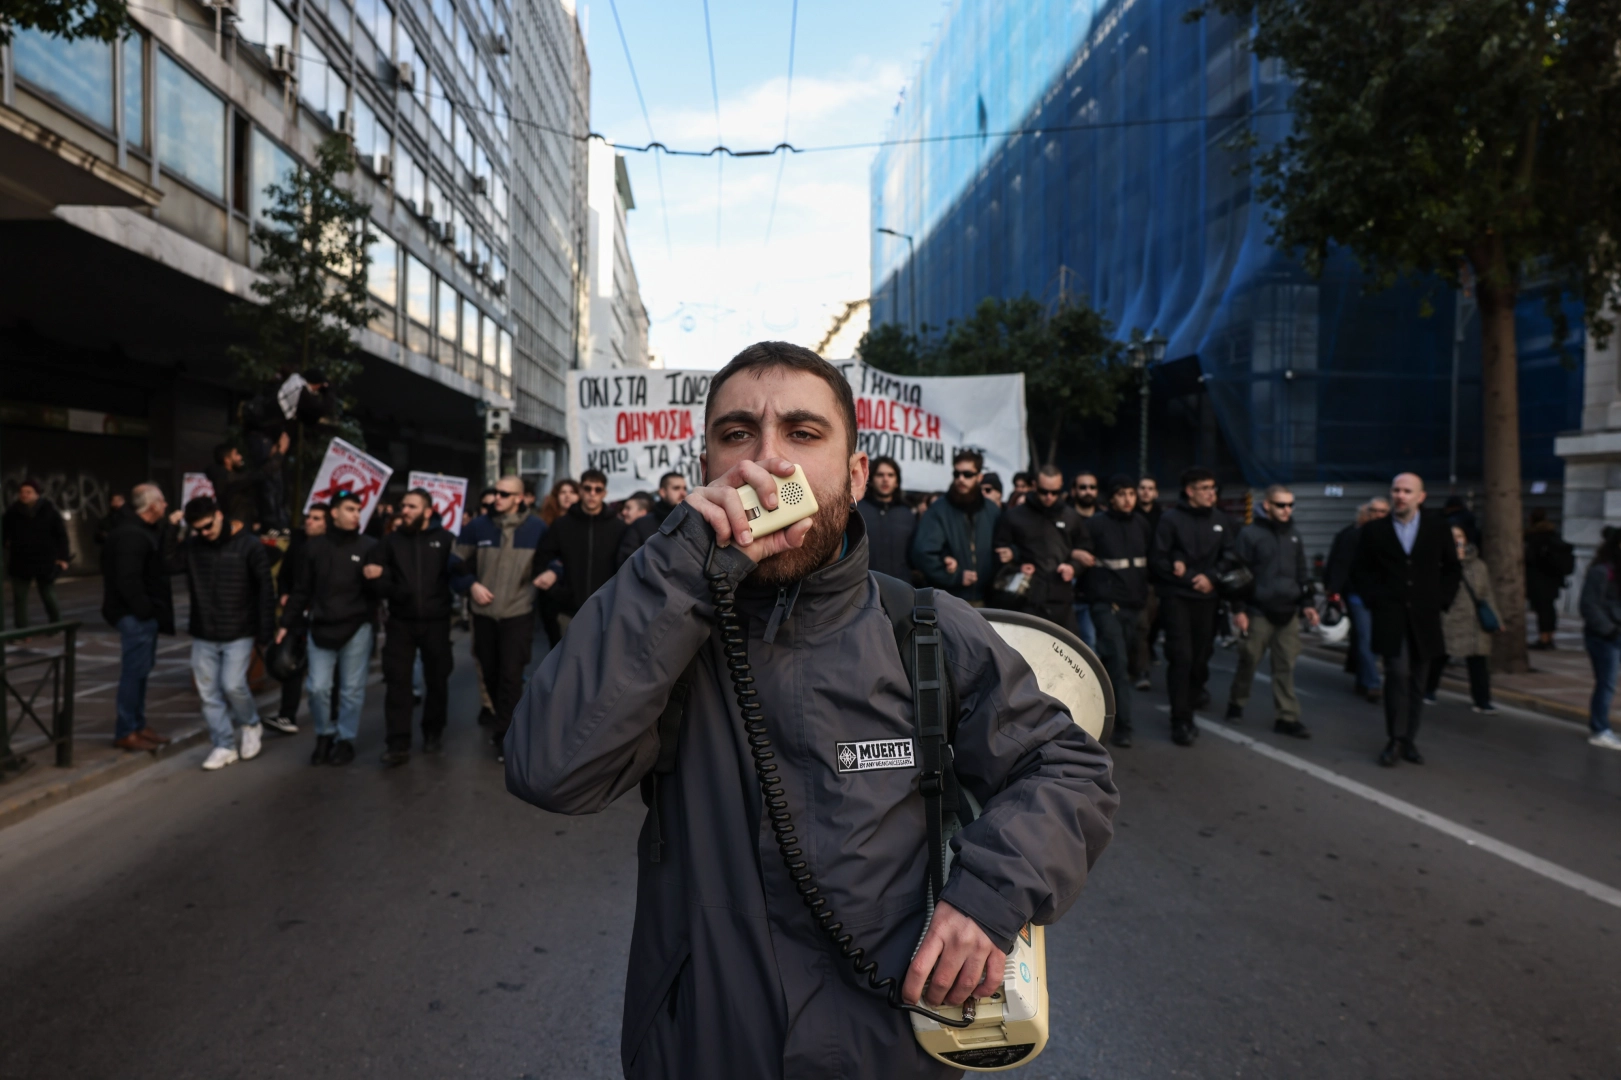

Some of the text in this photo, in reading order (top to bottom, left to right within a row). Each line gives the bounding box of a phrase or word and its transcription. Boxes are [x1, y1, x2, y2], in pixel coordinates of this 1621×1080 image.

[665, 371, 713, 406] ΙΔΙΩ
[616, 397, 942, 444] ΔΗΜΟΣΙΑ ΑΙΔΕΥΣΗ
[588, 447, 629, 474] ΚΑΤΩ
[643, 444, 670, 470] ΤΑ
[857, 431, 945, 466] ΡΟΟΠΤΙΚΗ
[859, 742, 911, 760] MUERTE
